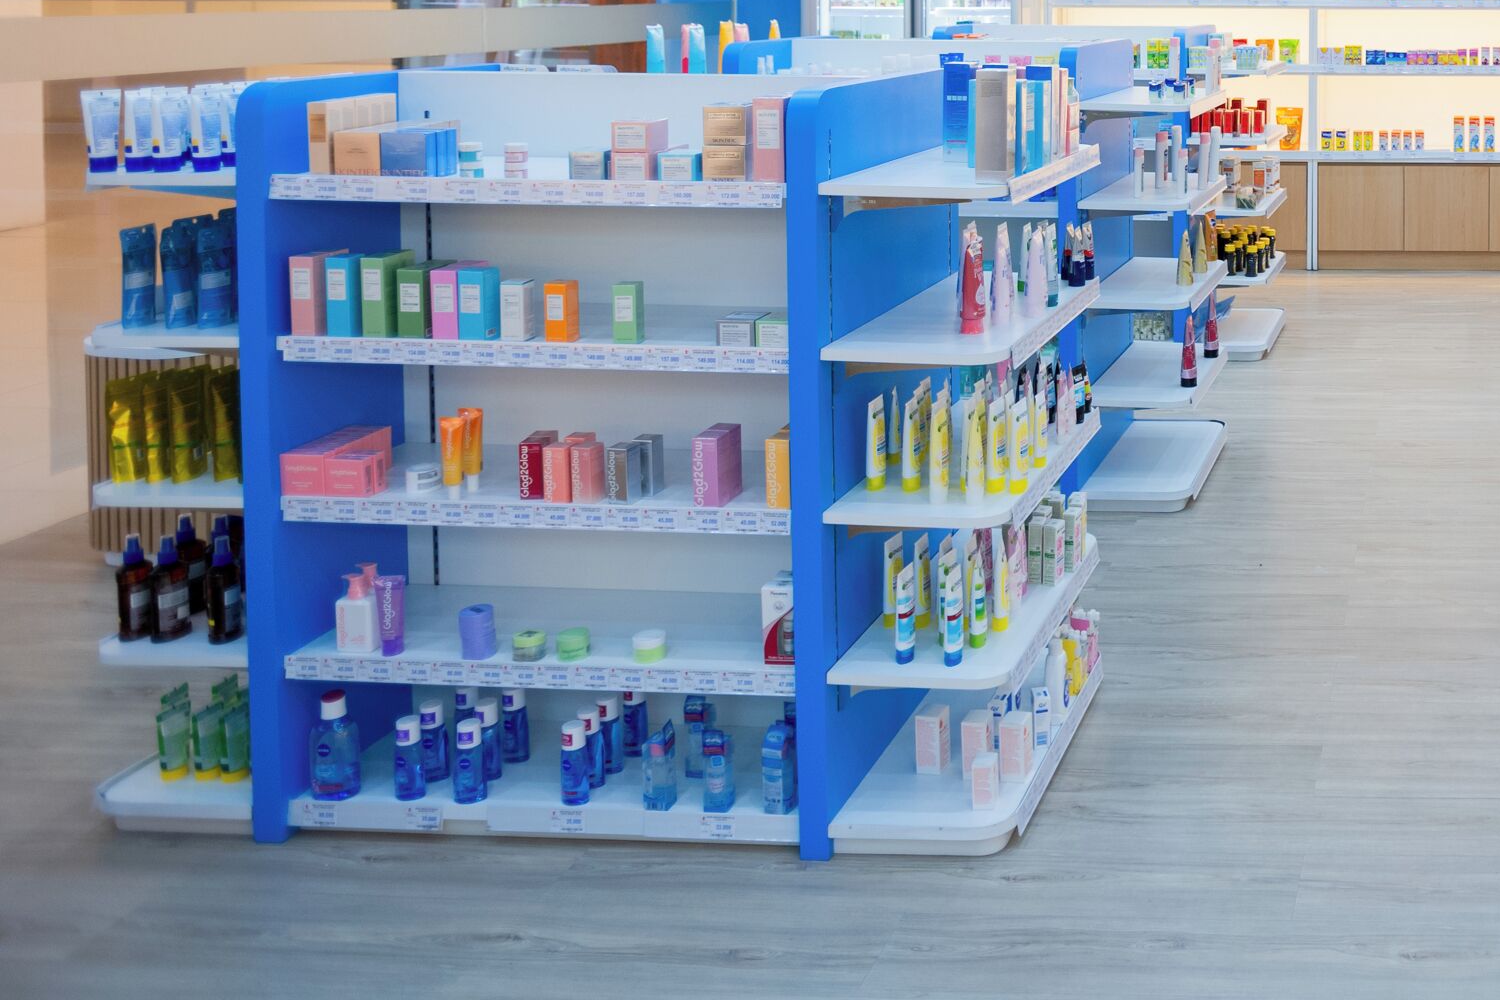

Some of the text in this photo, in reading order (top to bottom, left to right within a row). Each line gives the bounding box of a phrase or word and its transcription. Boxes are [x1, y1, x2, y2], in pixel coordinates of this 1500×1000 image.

[520, 445, 529, 499] Glad2Glow
[694, 440, 705, 508] Glad2Glow
[384, 581, 393, 629] Glad2Glow
